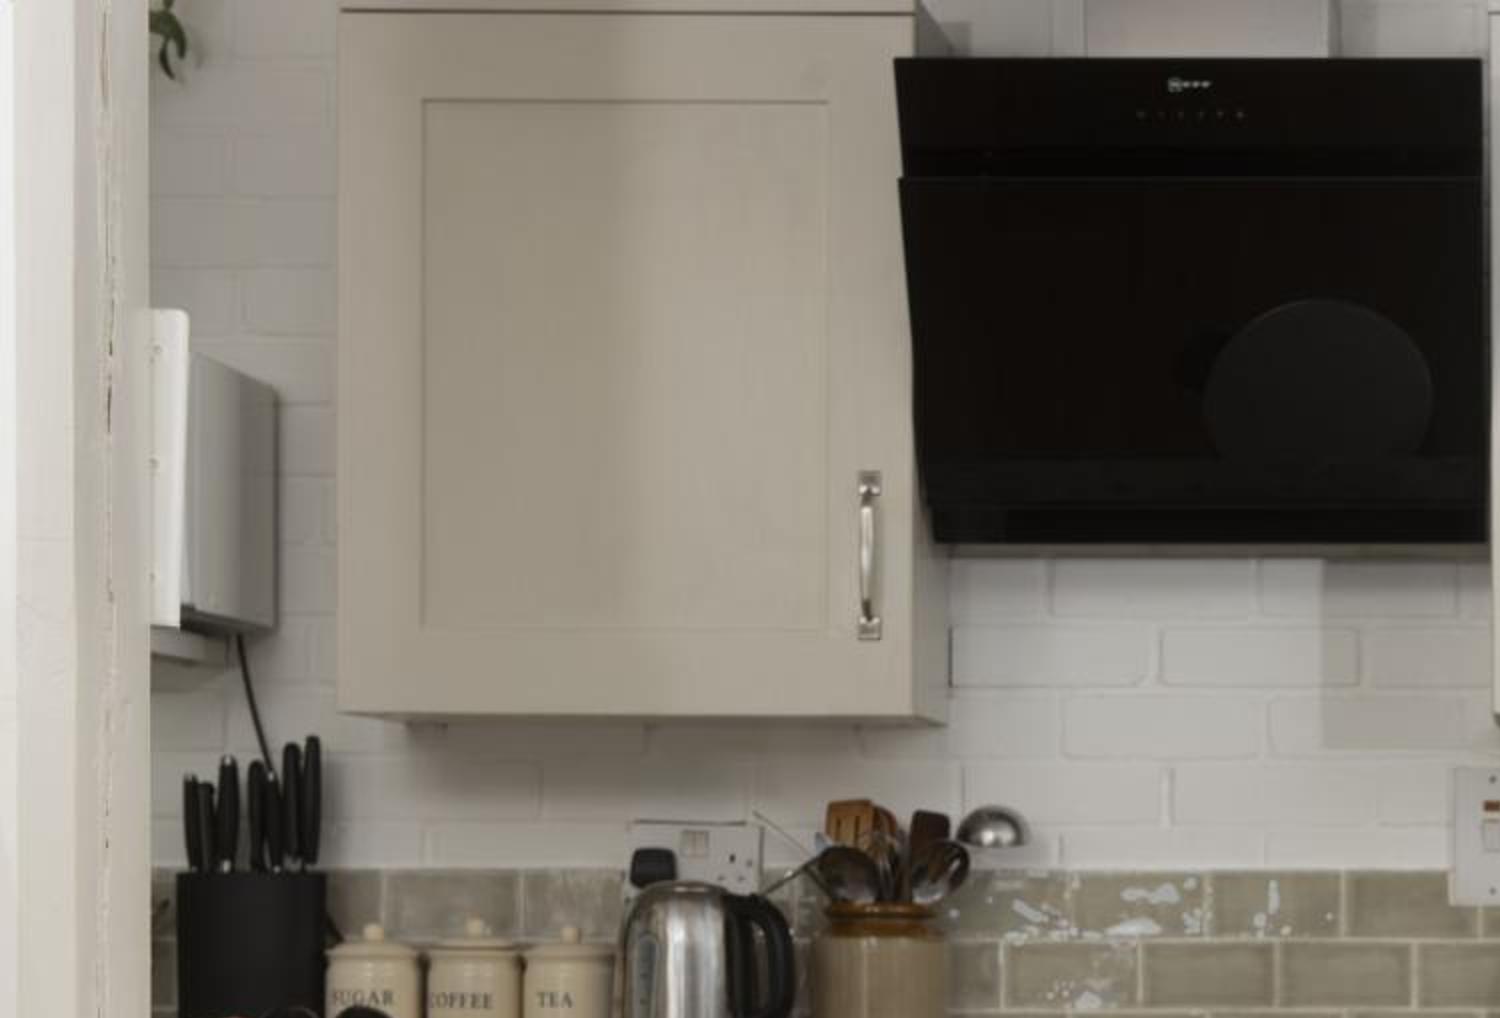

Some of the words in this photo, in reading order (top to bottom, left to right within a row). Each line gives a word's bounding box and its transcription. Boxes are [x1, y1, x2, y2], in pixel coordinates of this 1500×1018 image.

[332, 990, 394, 1006] SUGAR
[428, 991, 494, 1009] COFFEE
[536, 991, 574, 1009] TEA
